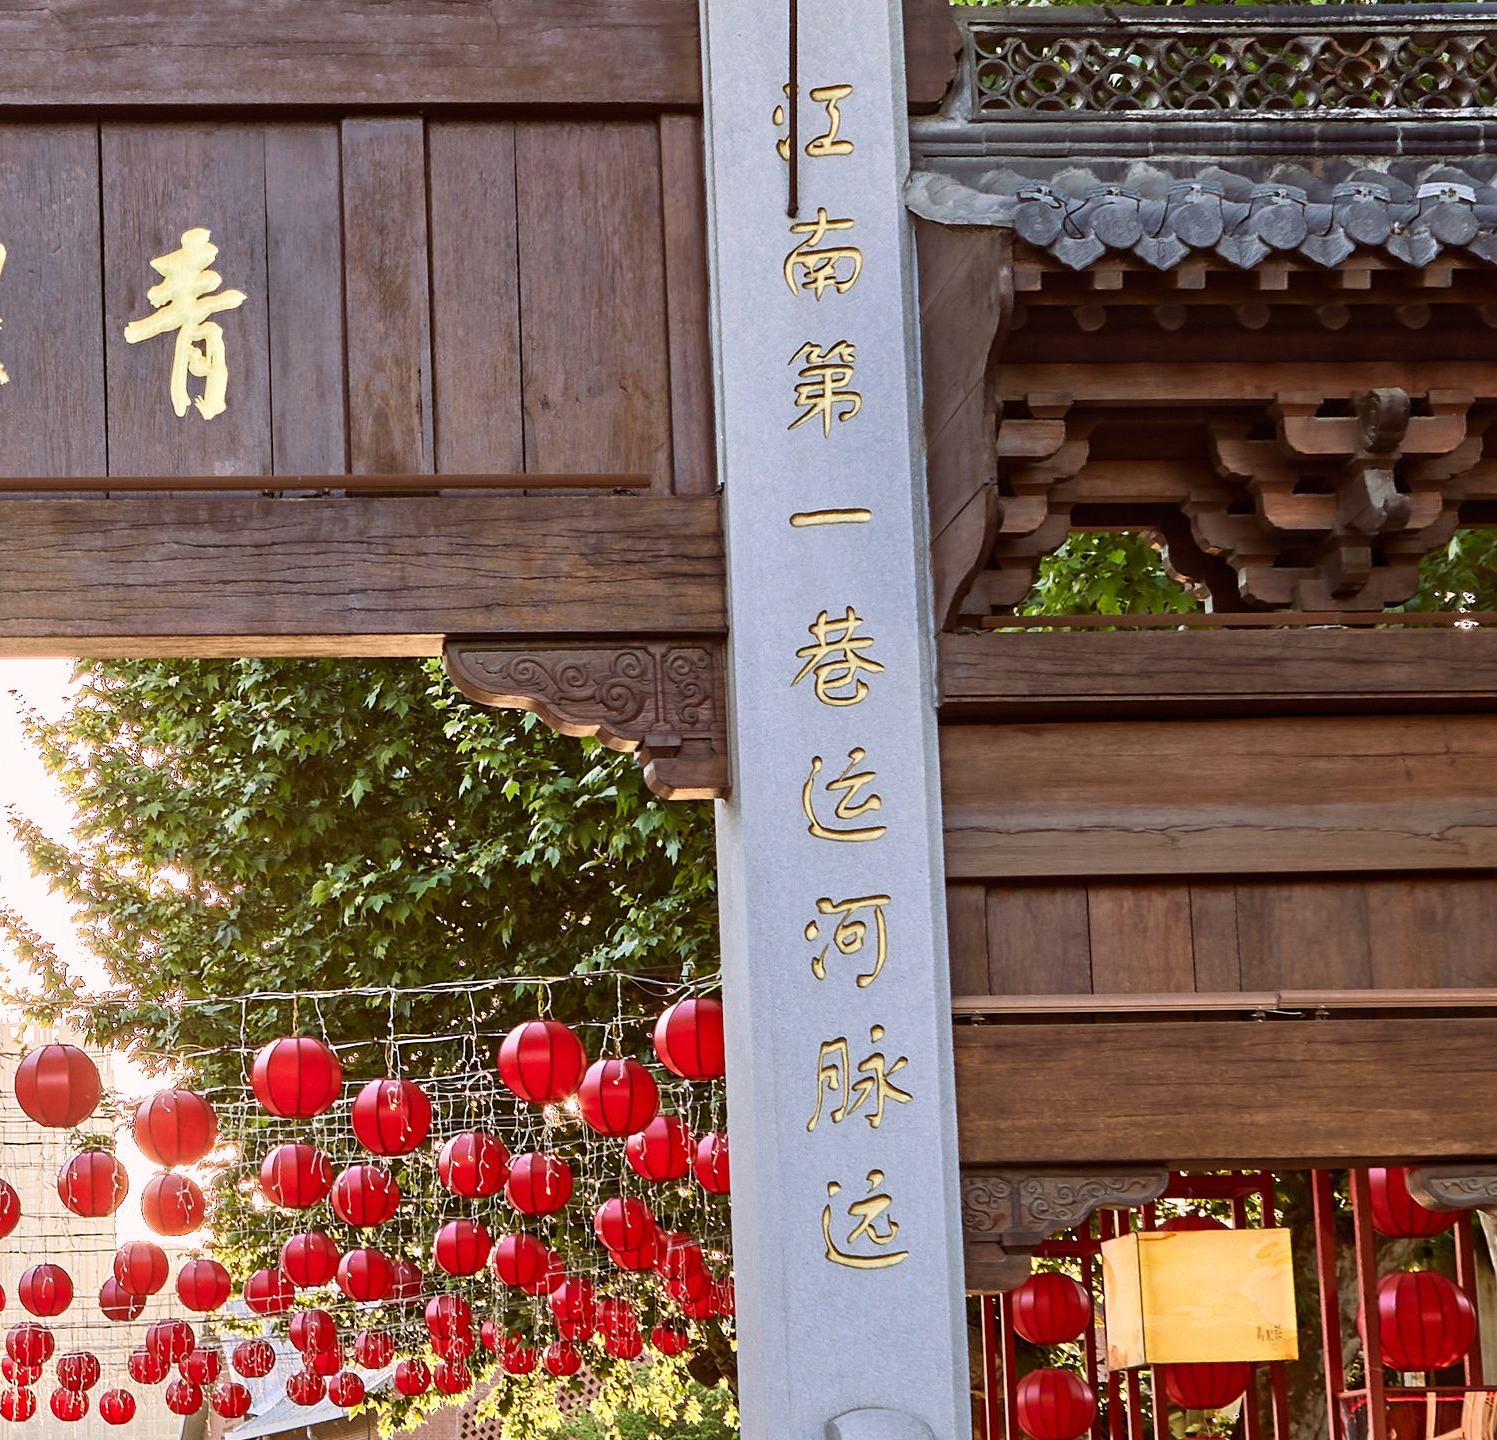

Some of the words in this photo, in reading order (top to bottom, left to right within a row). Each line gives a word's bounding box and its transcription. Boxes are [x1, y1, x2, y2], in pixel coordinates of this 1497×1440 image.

[772, 82, 913, 1270] 江南第一巷运河脉远
